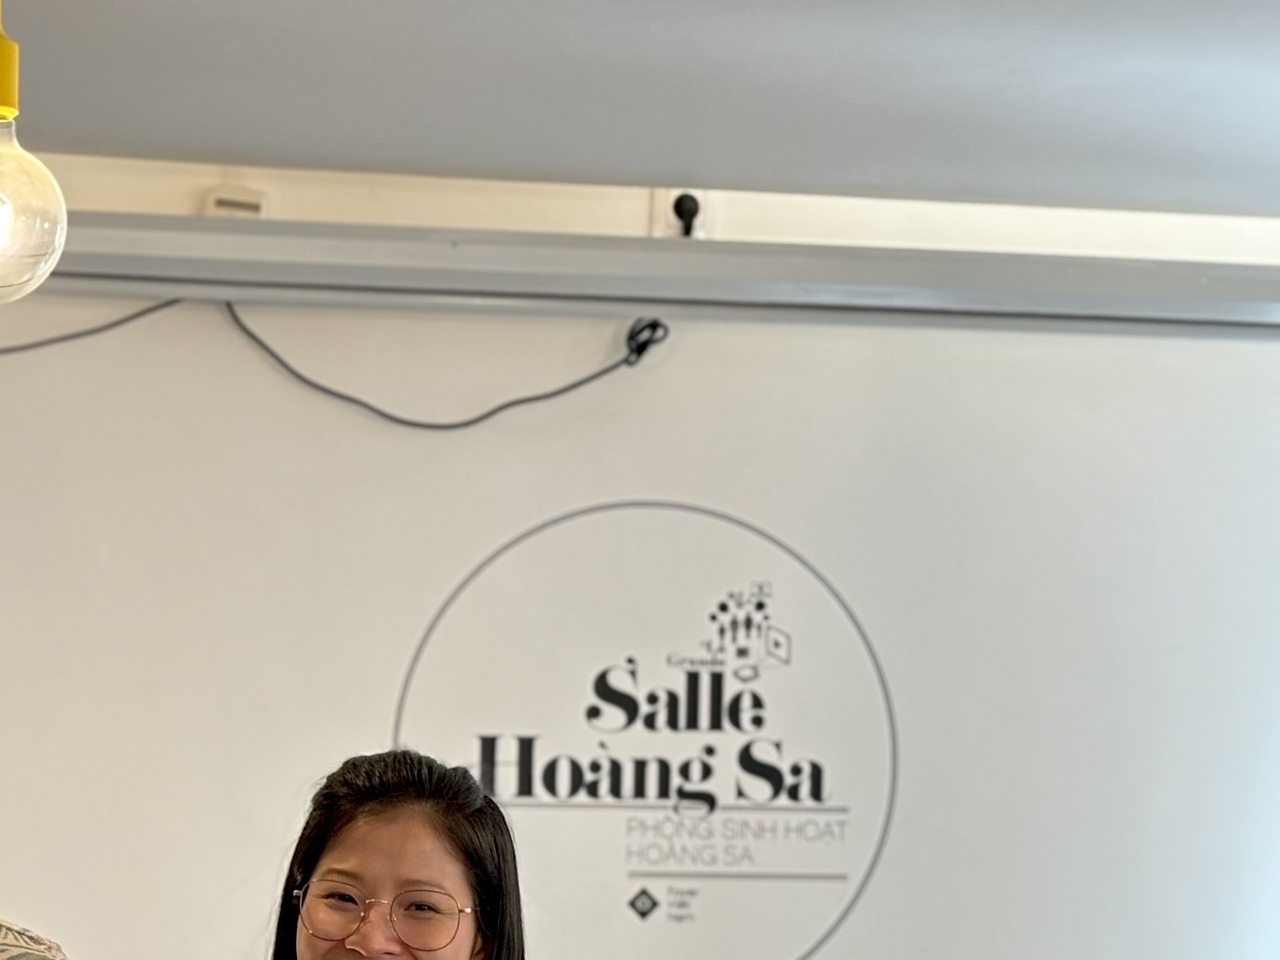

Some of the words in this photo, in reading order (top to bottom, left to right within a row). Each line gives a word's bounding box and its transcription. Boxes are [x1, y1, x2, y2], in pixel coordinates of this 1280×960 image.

[586, 656, 765, 734] Salle
[475, 734, 718, 820] Hoàng
[734, 738, 827, 805] Sa
[721, 817, 777, 841] SINH
[722, 843, 755, 867] SA
